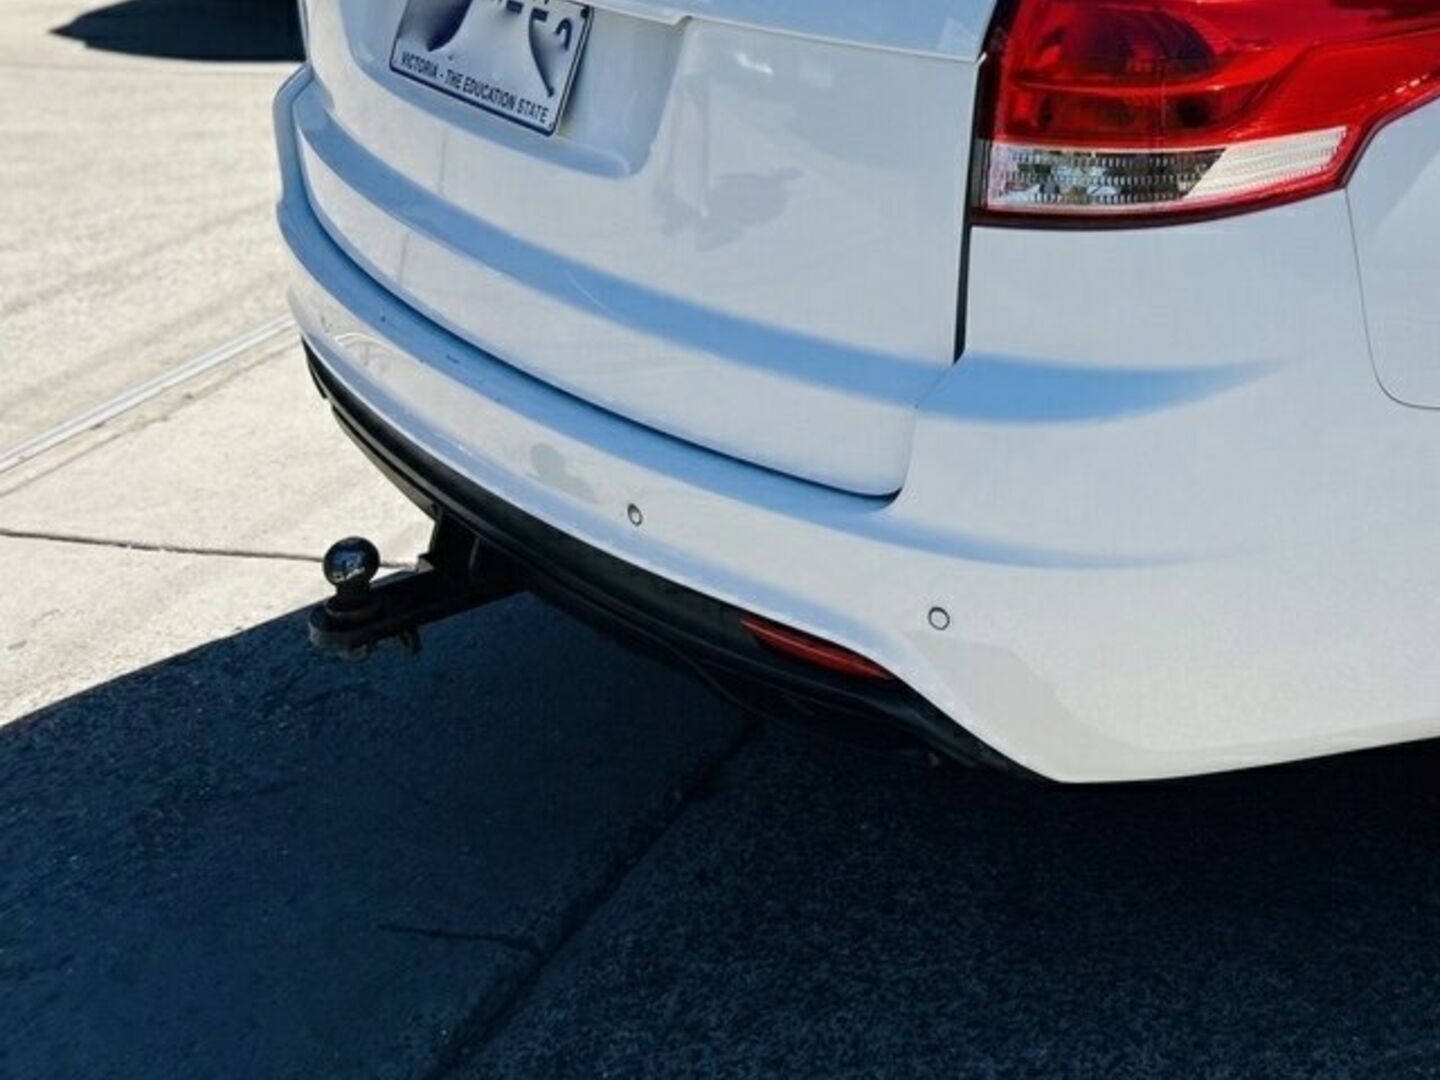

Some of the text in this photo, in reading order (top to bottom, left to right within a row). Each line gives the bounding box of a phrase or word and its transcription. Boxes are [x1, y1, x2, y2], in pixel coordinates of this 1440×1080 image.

[401, 51, 438, 78] VICTORIA
[447, 69, 463, 90] THE
[463, 79, 516, 110] EDUCATION
[517, 98, 550, 124] STATE
